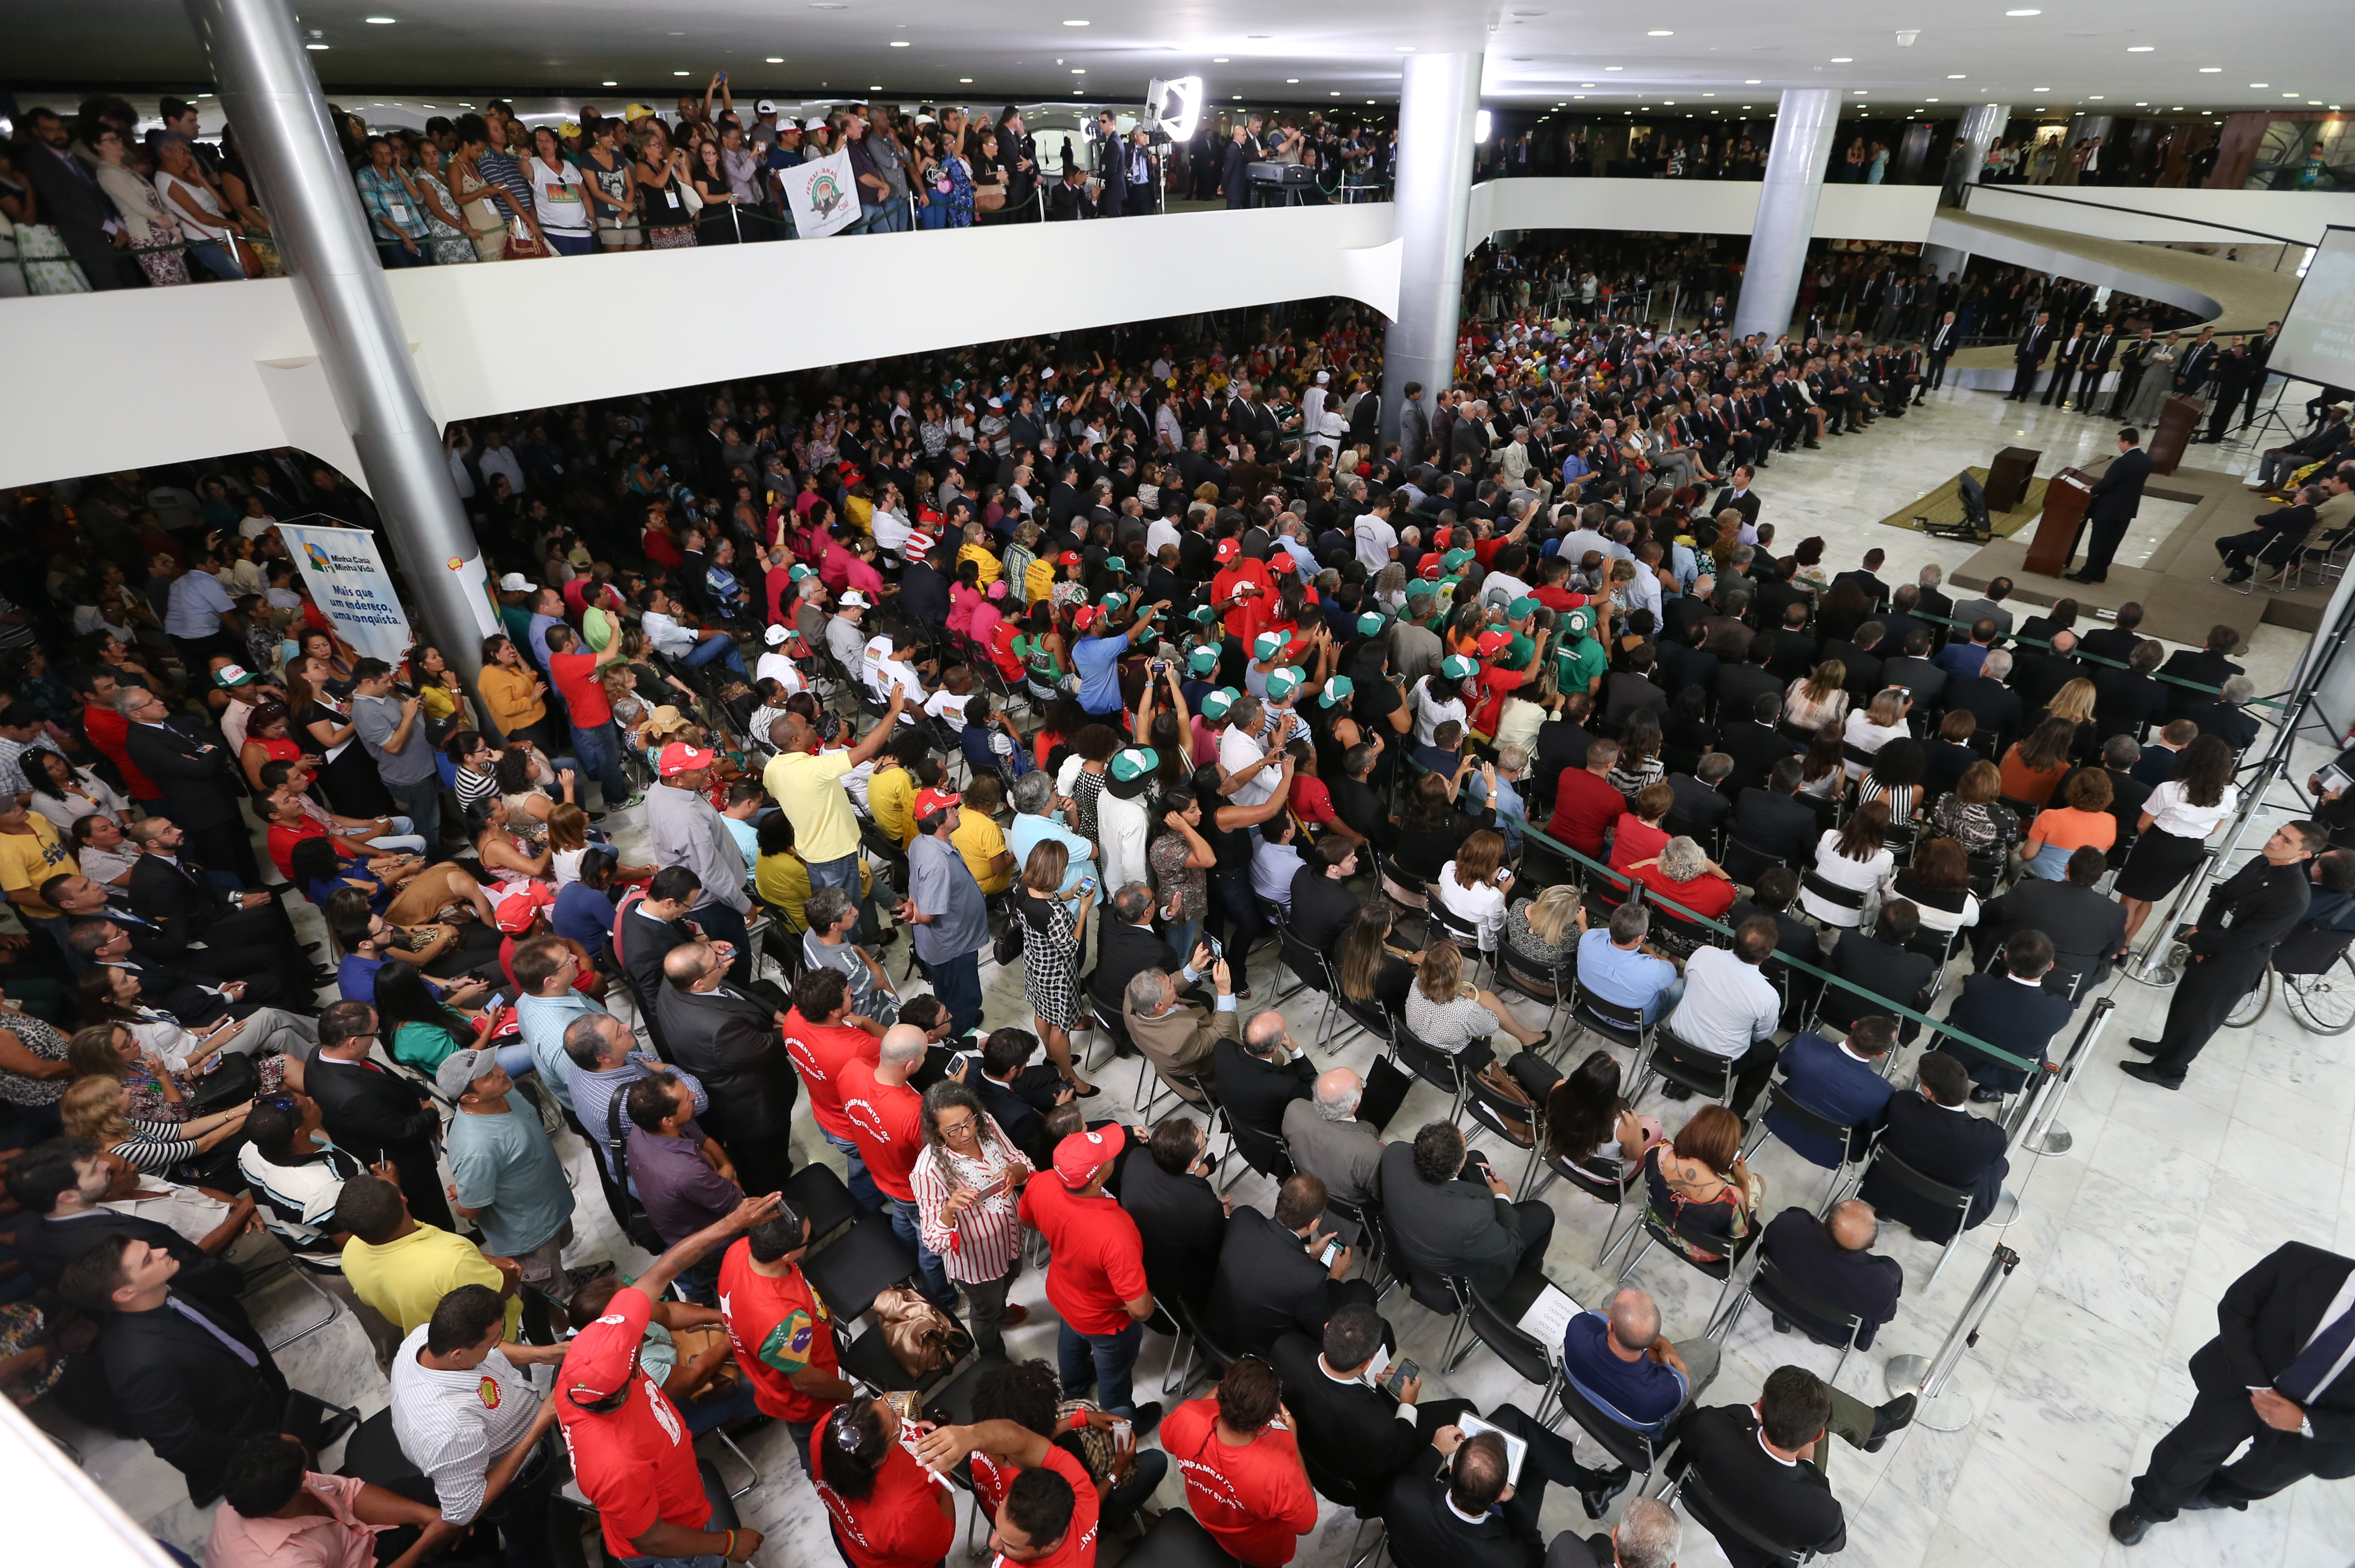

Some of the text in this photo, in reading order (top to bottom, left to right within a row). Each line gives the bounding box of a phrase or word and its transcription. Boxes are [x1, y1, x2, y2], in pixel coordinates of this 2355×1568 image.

[806, 171, 818, 195] FETRAF
[332, 555, 352, 564] Minha
[334, 563, 375, 573] Minha Vida
[333, 585, 373, 599] Mais que
[330, 598, 392, 615] um endereço,
[332, 611, 401, 627] uma conquista.
[817, 1070, 827, 1080] DF
[845, 1098, 880, 1124] ACAMPAMENTO
[881, 1131, 891, 1142] DF
[869, 1128, 885, 1143] STANG
[1086, 1165, 1099, 1179] FNL
[971, 1450, 1002, 1490] MPAMENTO
[1213, 1492, 1236, 1509] STANG
